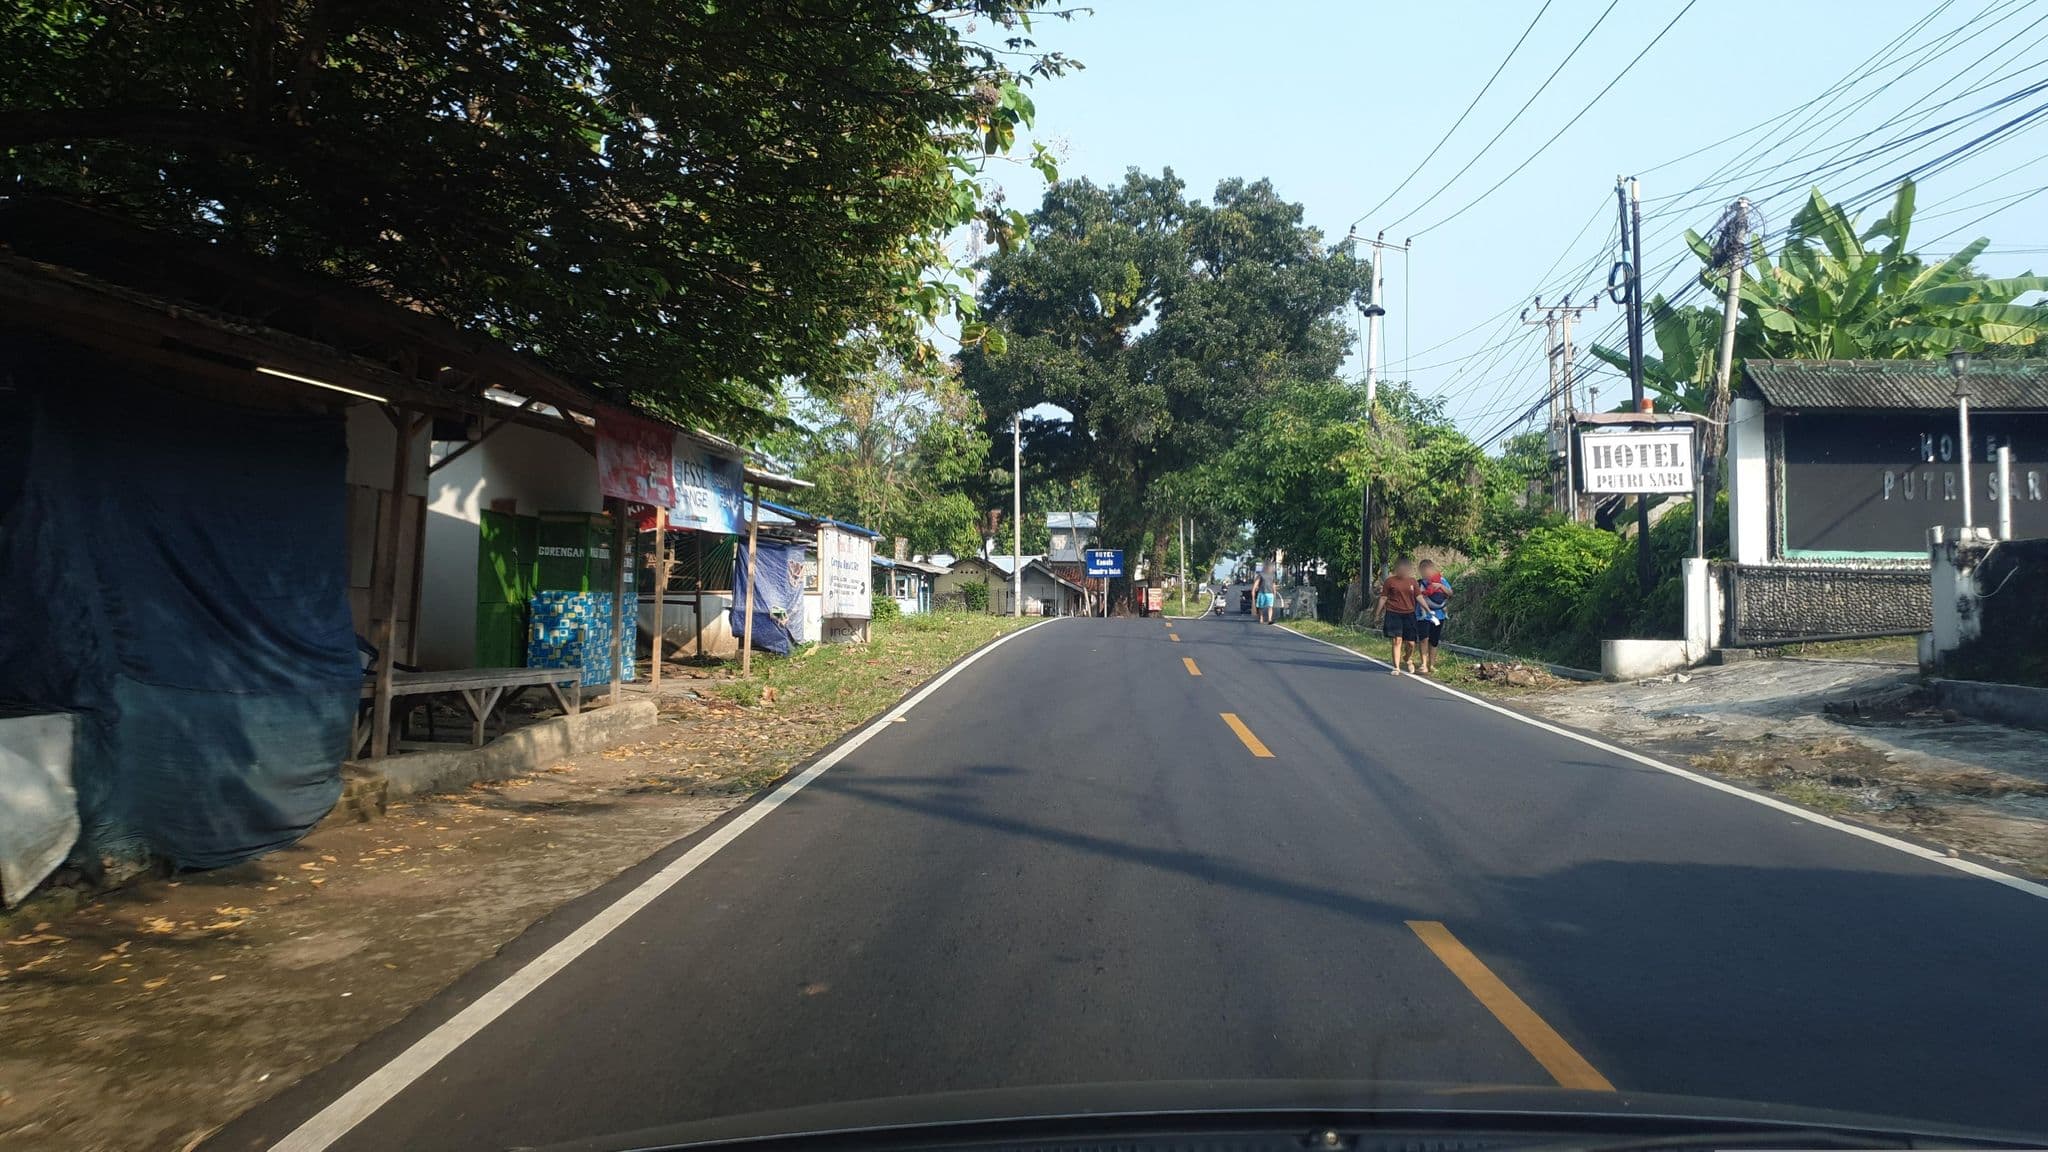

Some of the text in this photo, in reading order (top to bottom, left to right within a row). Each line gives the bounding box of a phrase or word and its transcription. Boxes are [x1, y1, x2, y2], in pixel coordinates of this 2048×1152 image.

[1592, 443, 1685, 469] HOTEL
[684, 461, 708, 490] ESSE
[1597, 472, 1684, 488] PUTRI SARI
[1883, 471, 1958, 500] PUTR
[538, 546, 584, 559] GORENGAN
